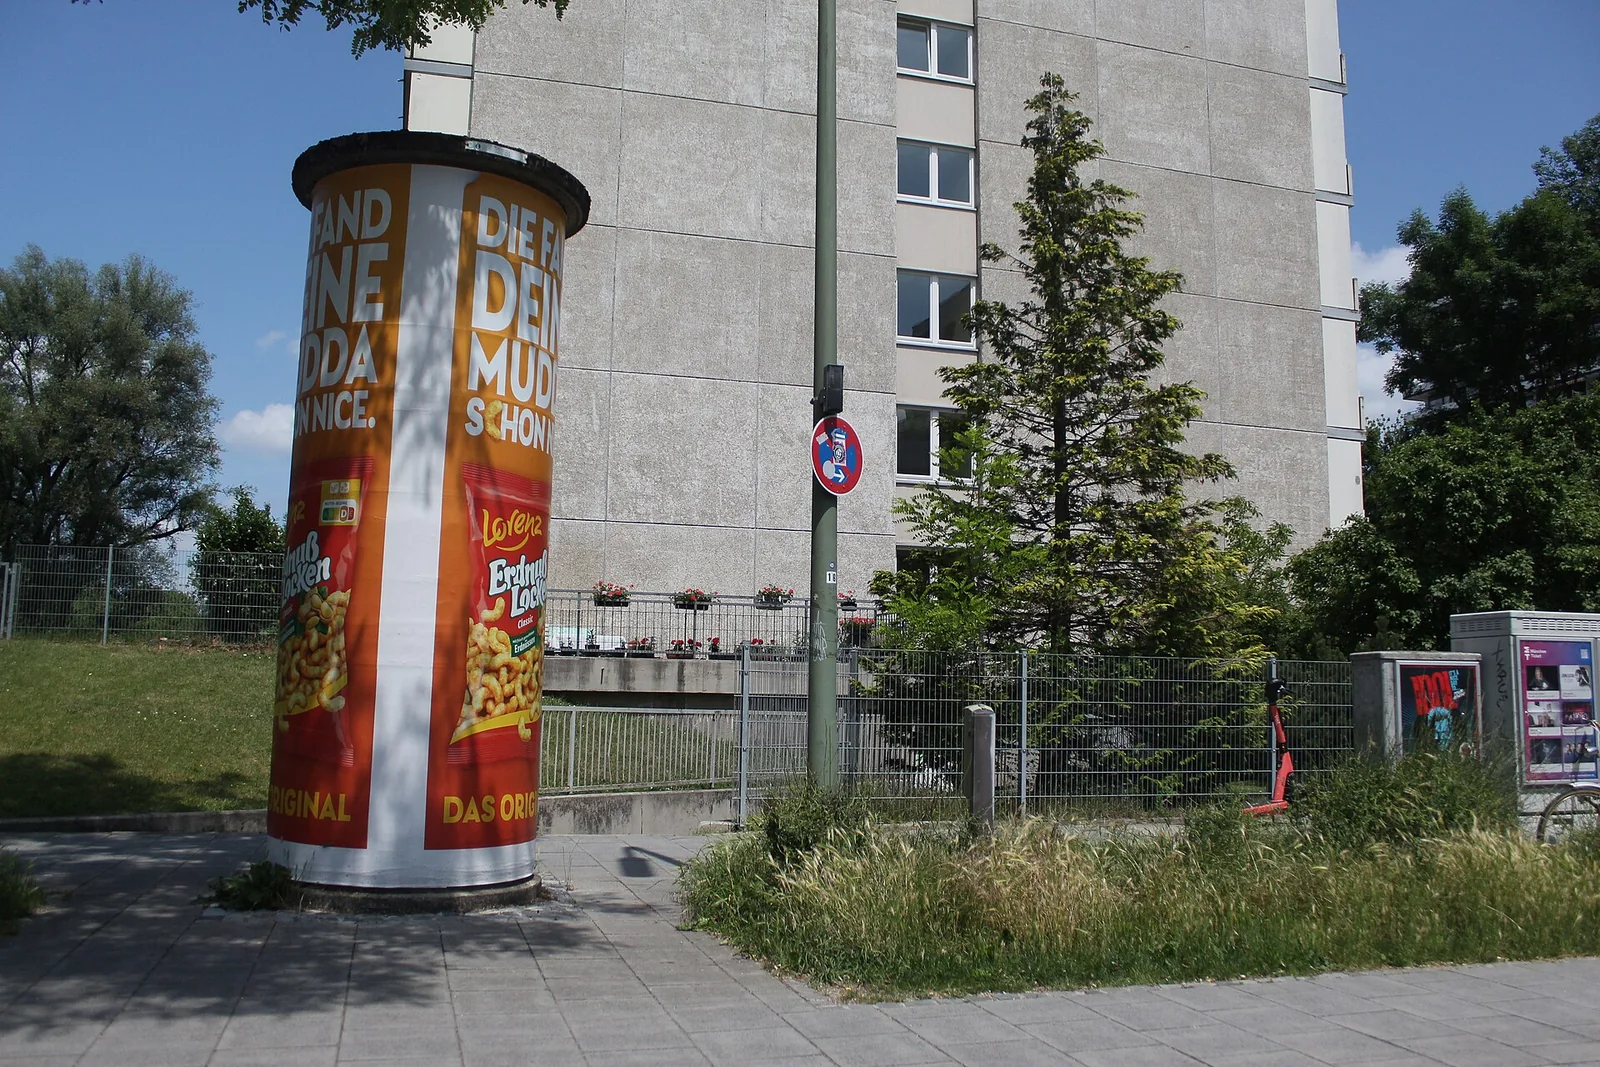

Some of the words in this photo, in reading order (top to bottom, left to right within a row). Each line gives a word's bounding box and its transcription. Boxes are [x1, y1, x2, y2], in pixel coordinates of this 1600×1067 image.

[477, 195, 537, 261] DIE
[311, 390, 376, 432] NICE.
[482, 508, 543, 547] Lorenz
[517, 614, 534, 629] Classic
[443, 795, 496, 823] DAS
